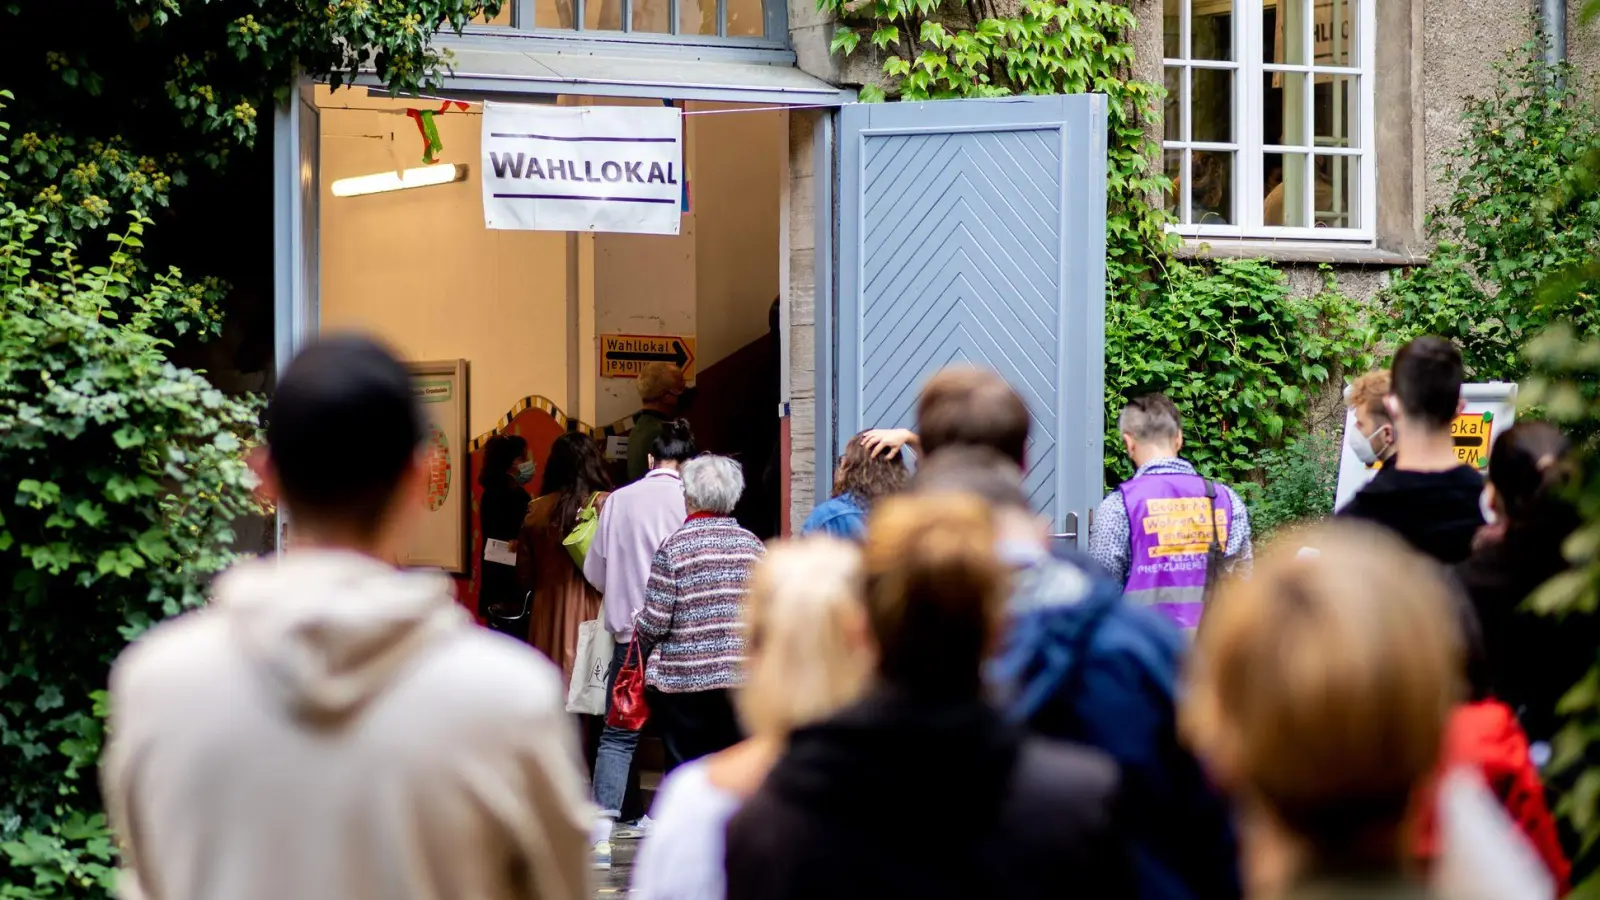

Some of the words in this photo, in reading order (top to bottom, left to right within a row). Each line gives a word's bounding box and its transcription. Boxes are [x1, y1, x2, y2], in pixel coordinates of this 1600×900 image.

[490, 152, 677, 184] WAHLLOKAL
[607, 339, 669, 352] Wahllokal
[1451, 420, 1484, 434] okal
[1453, 448, 1479, 464] Wa
